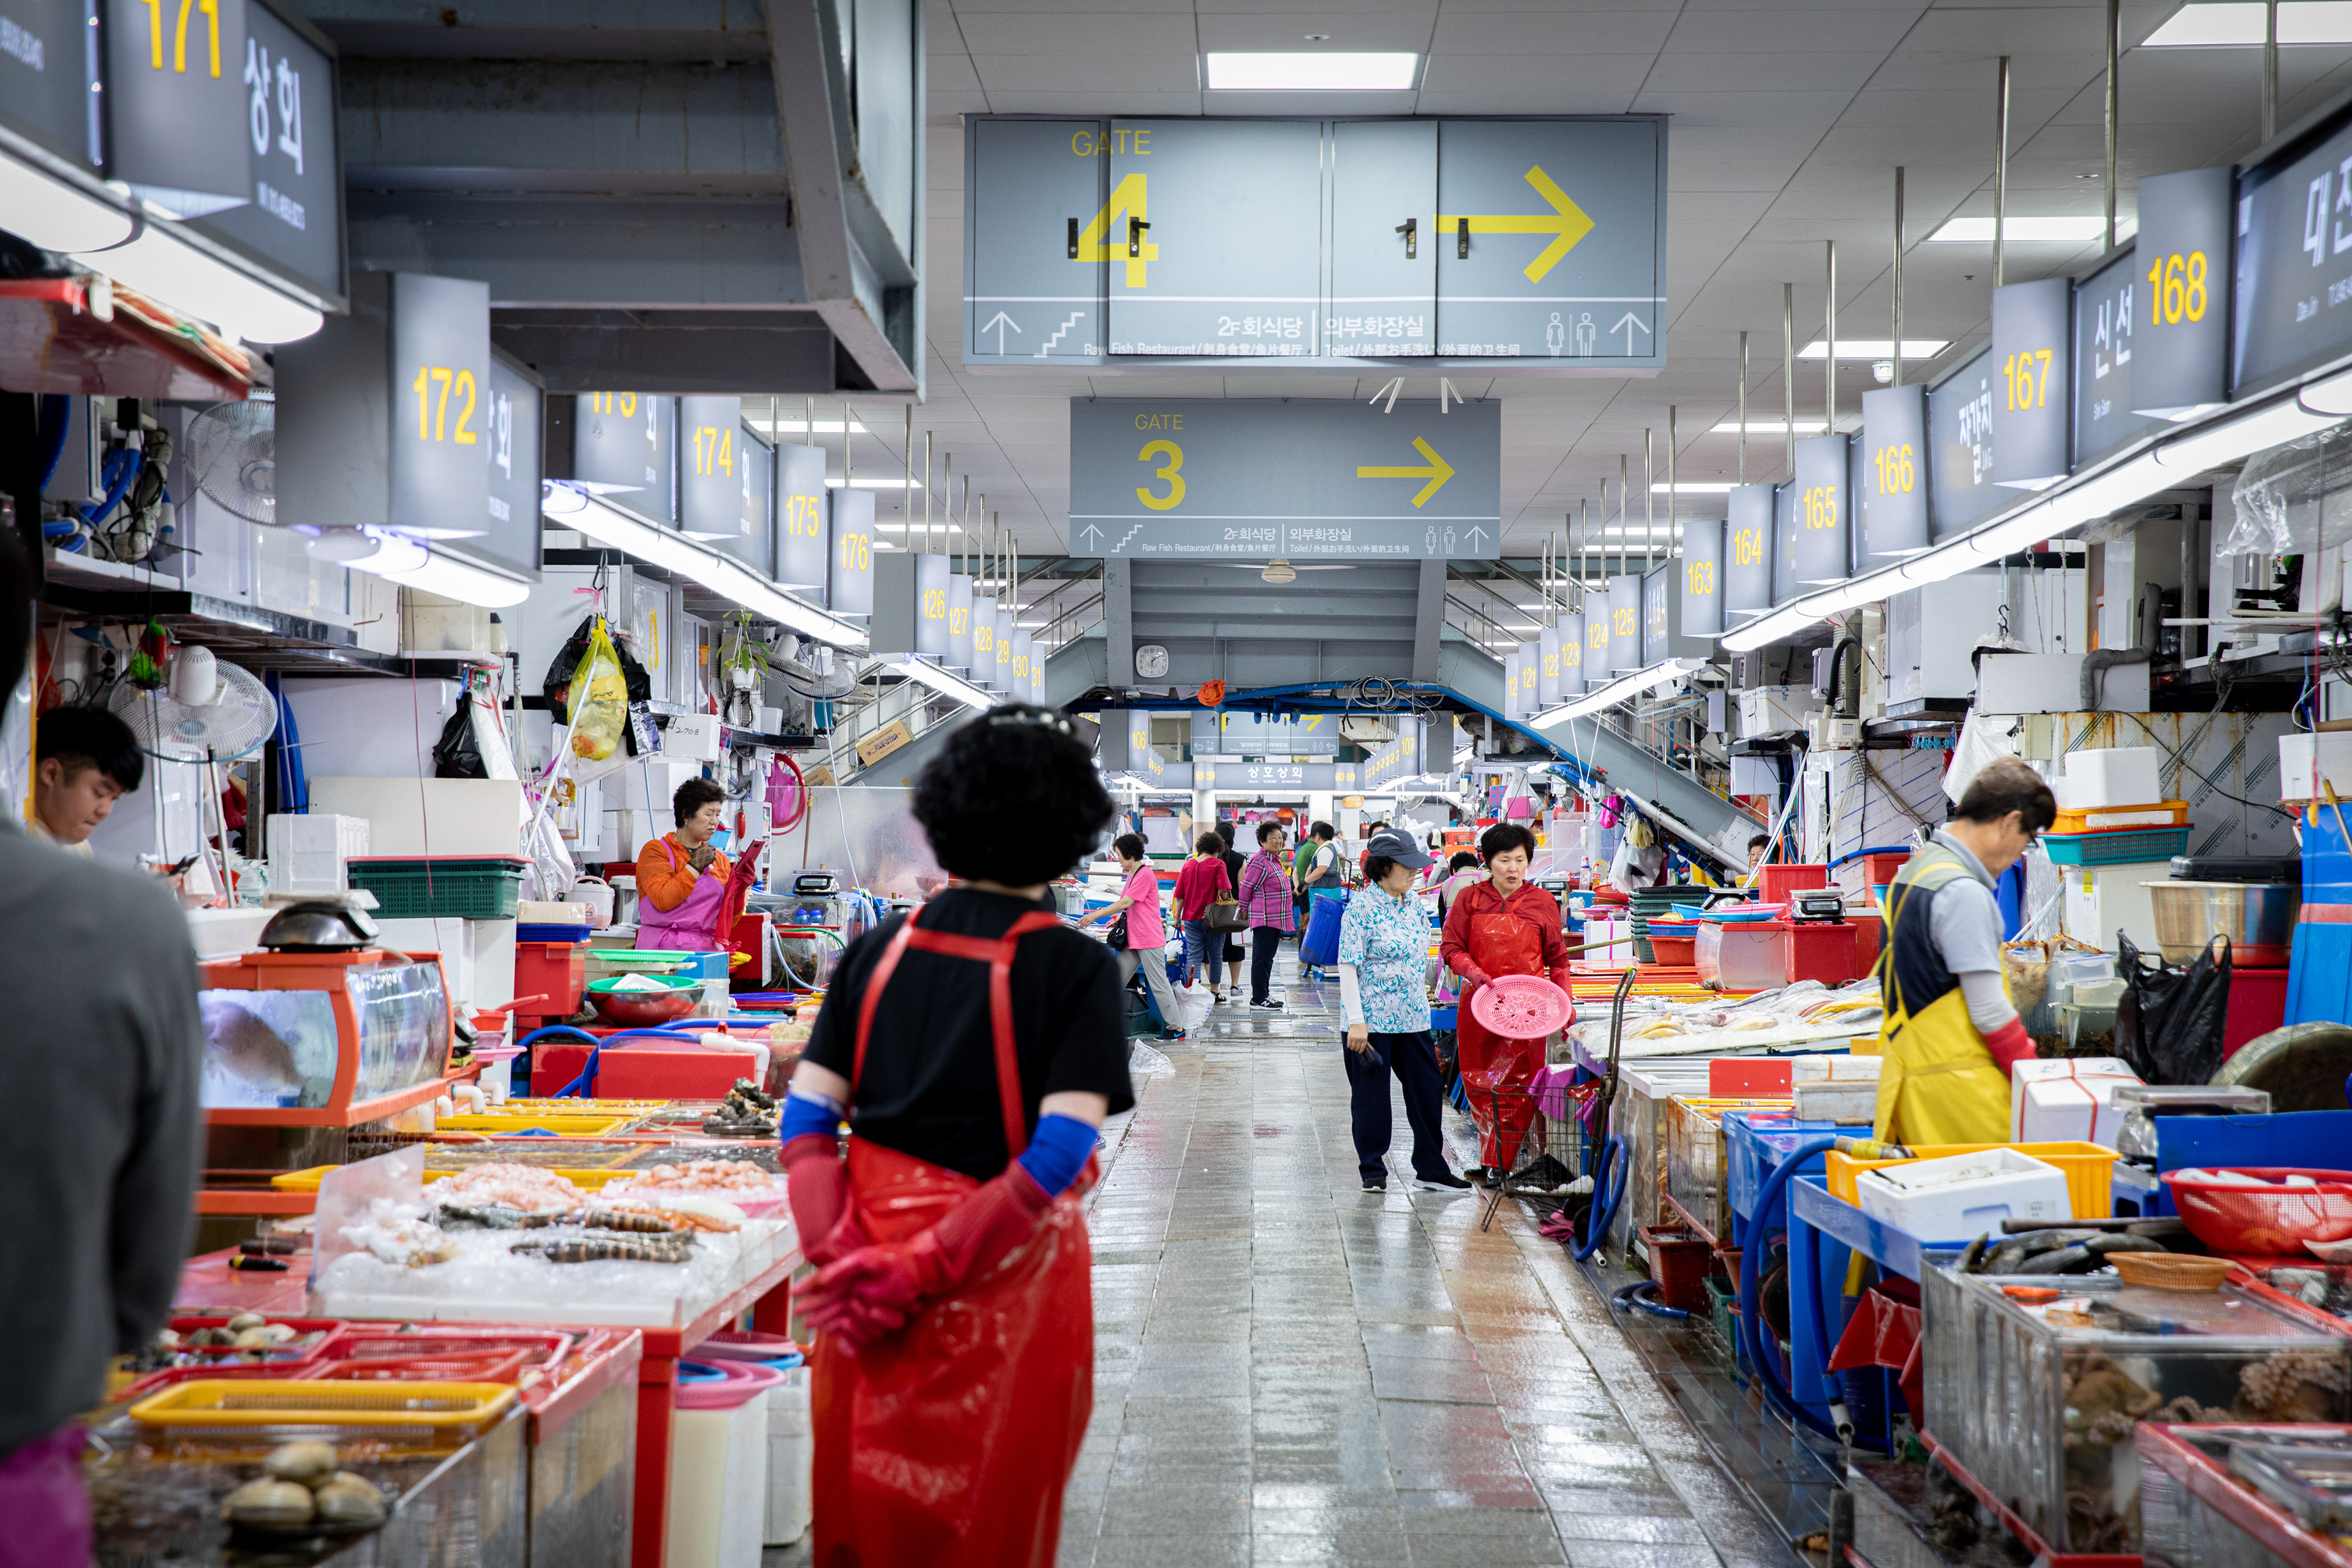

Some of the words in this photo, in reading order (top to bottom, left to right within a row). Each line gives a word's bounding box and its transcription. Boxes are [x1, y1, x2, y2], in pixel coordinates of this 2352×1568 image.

[1071, 130, 1151, 157] GATE
[1074, 174, 1158, 288] 4
[2148, 251, 2207, 326] 168
[1084, 343, 1108, 356] Raw
[1112, 342, 1133, 355] Fish
[2003, 349, 2052, 412] 167
[413, 366, 477, 445] 172
[488, 390, 512, 480] 회
[1135, 414, 1183, 431] GATE
[693, 426, 733, 478] 174
[1136, 440, 1186, 511] 3
[1875, 444, 1913, 496] 166
[786, 494, 818, 537] 175
[1803, 486, 1837, 530] 165
[1289, 528, 1351, 541] 외부화장실
[1733, 527, 1762, 566] 164
[840, 532, 869, 571] 176
[1687, 560, 1714, 595] 163
[923, 589, 945, 620] 126
[949, 608, 968, 635] 127
[1613, 608, 1635, 636] 125
[974, 626, 993, 652] 128
[1589, 623, 1608, 649] 124
[997, 639, 1009, 663] 29
[1561, 642, 1579, 667] 123
[1012, 655, 1028, 677] 130
[1031, 666, 1041, 687] 31
[1523, 666, 1536, 688] 121
[1544, 654, 1559, 677] 122
[1508, 676, 1518, 696] 12
[1133, 731, 1146, 749] 106
[1401, 737, 1415, 756] 107
[1196, 771, 1205, 781] 59
[1206, 771, 1215, 781] 59
[1335, 772, 1344, 782] 60
[1346, 772, 1355, 782] 60
[2217, 772, 2228, 784] HAN
[2247, 777, 2263, 794] METAL
[1877, 818, 1893, 827] STAINLESS
[2206, 842, 2222, 857] METAL
[2220, 818, 2241, 842] COMPANY
